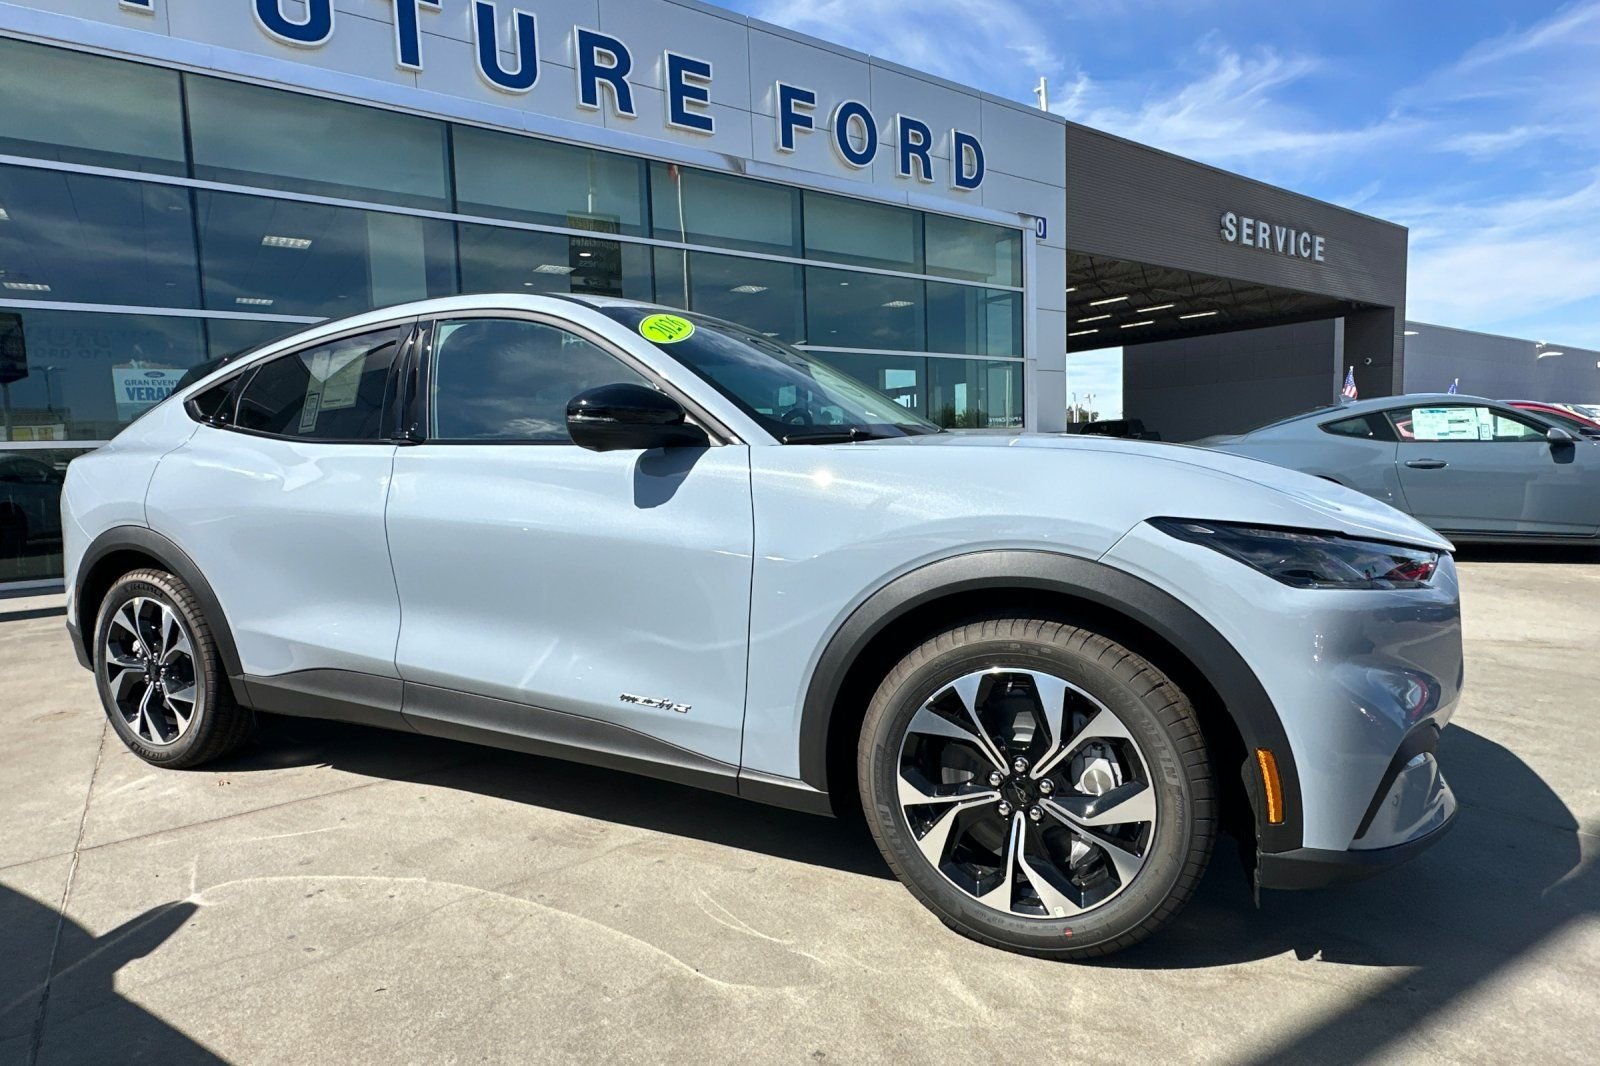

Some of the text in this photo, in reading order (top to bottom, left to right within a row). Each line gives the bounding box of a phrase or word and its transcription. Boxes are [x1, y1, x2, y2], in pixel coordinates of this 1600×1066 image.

[118, 0, 986, 191] UTURE FORD
[1221, 211, 1325, 262] SERVICE
